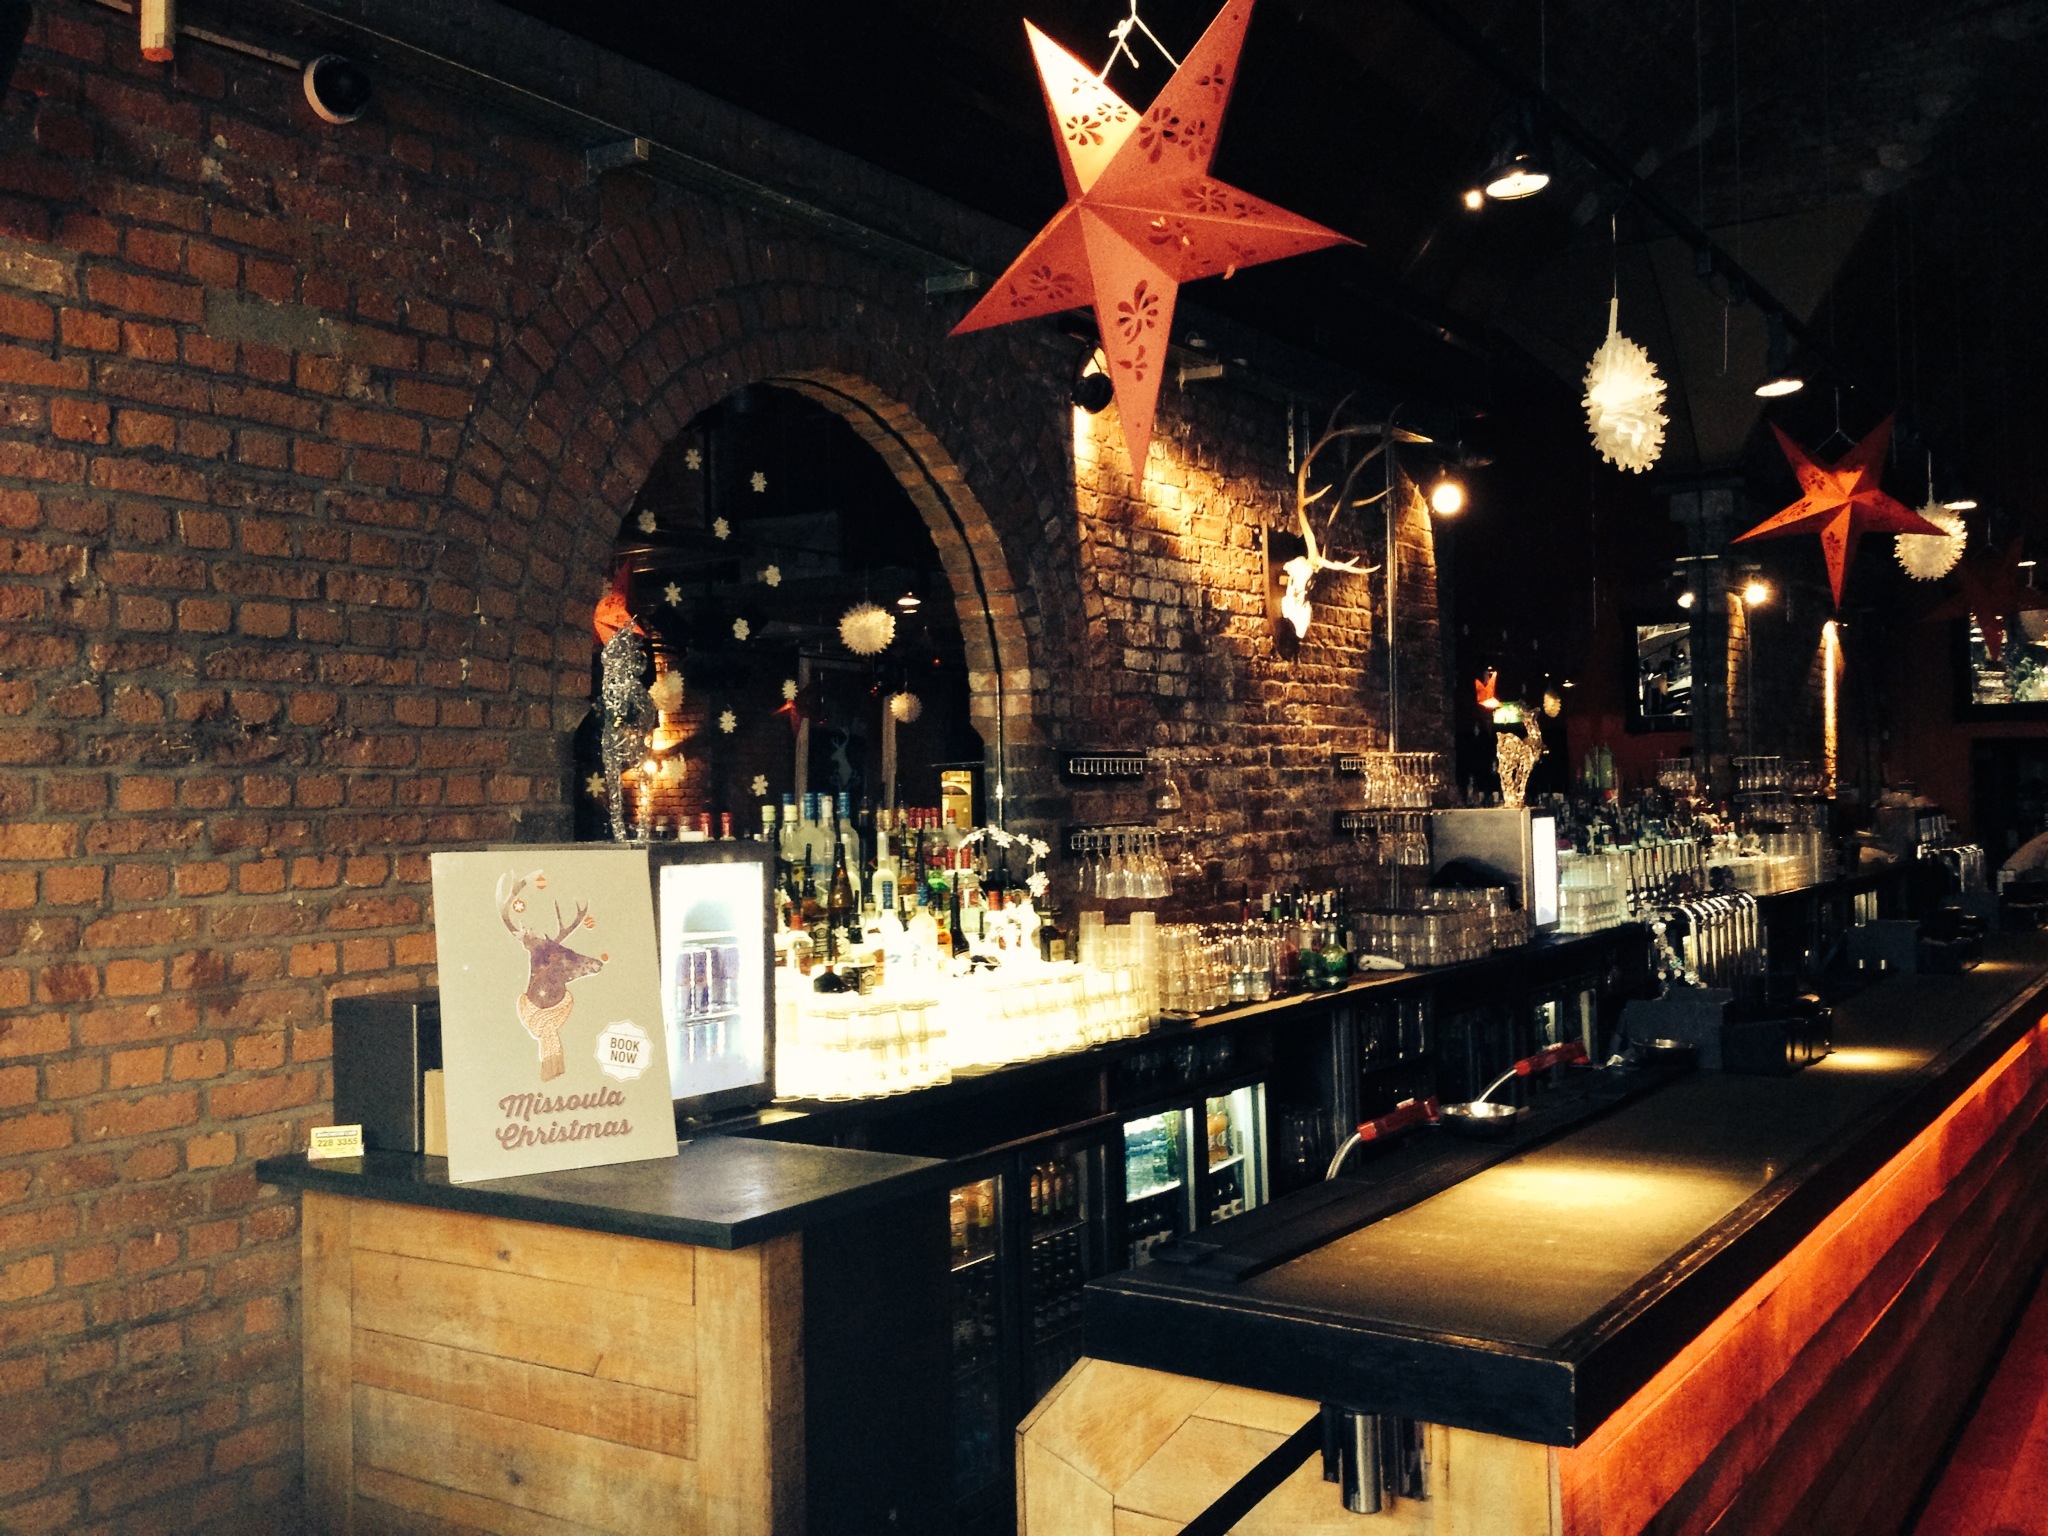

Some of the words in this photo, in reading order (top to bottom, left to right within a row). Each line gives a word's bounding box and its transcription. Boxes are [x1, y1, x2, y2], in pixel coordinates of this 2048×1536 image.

[610, 1037, 640, 1052] BOOK
[610, 1050, 638, 1064] NOW
[499, 1086, 626, 1121] Missoula
[495, 1119, 633, 1150] Christmas
[318, 1139, 333, 1147] 228
